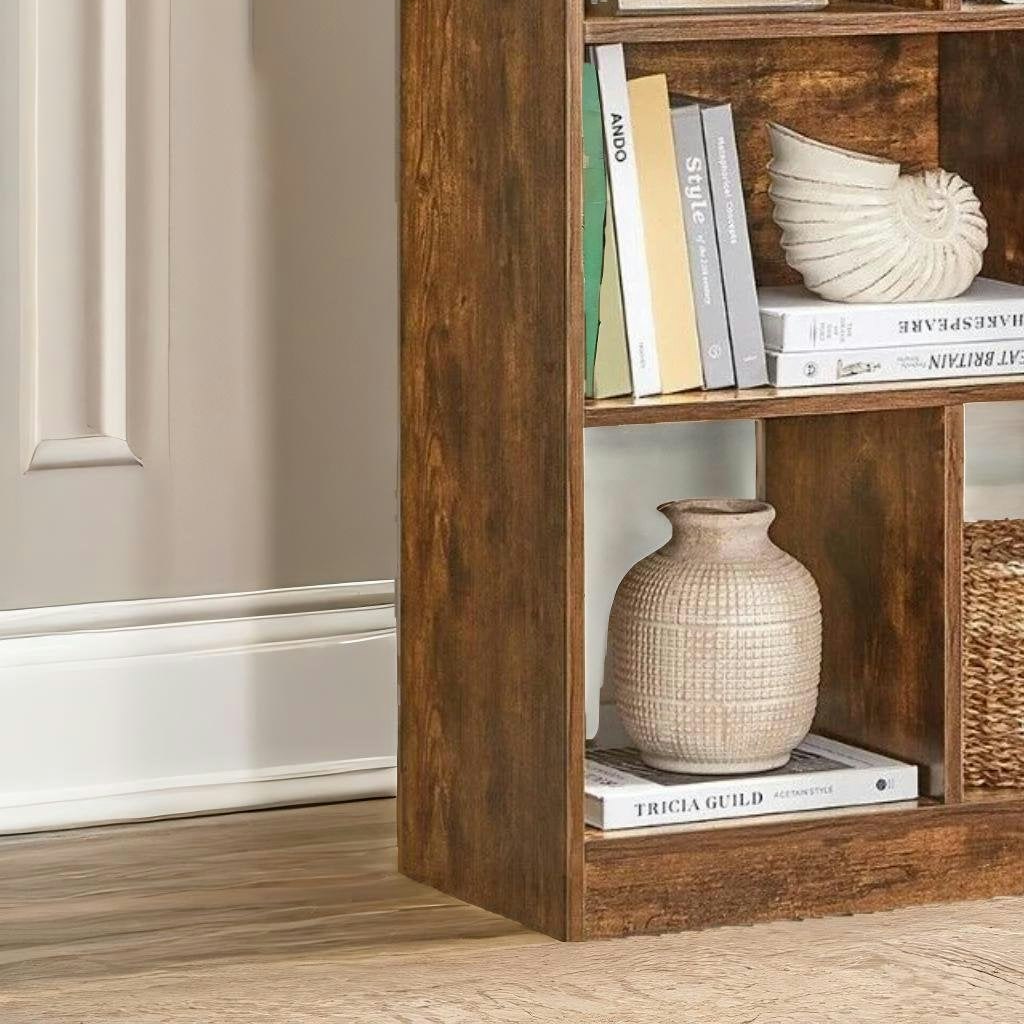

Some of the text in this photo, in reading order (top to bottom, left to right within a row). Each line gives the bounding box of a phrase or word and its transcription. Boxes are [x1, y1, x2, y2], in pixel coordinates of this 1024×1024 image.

[609, 112, 628, 164] ANDO
[685, 155, 709, 225] Style
[928, 350, 994, 370] BRITAIN
[634, 798, 703, 818] TRICIA
[705, 792, 764, 810] GUILD
